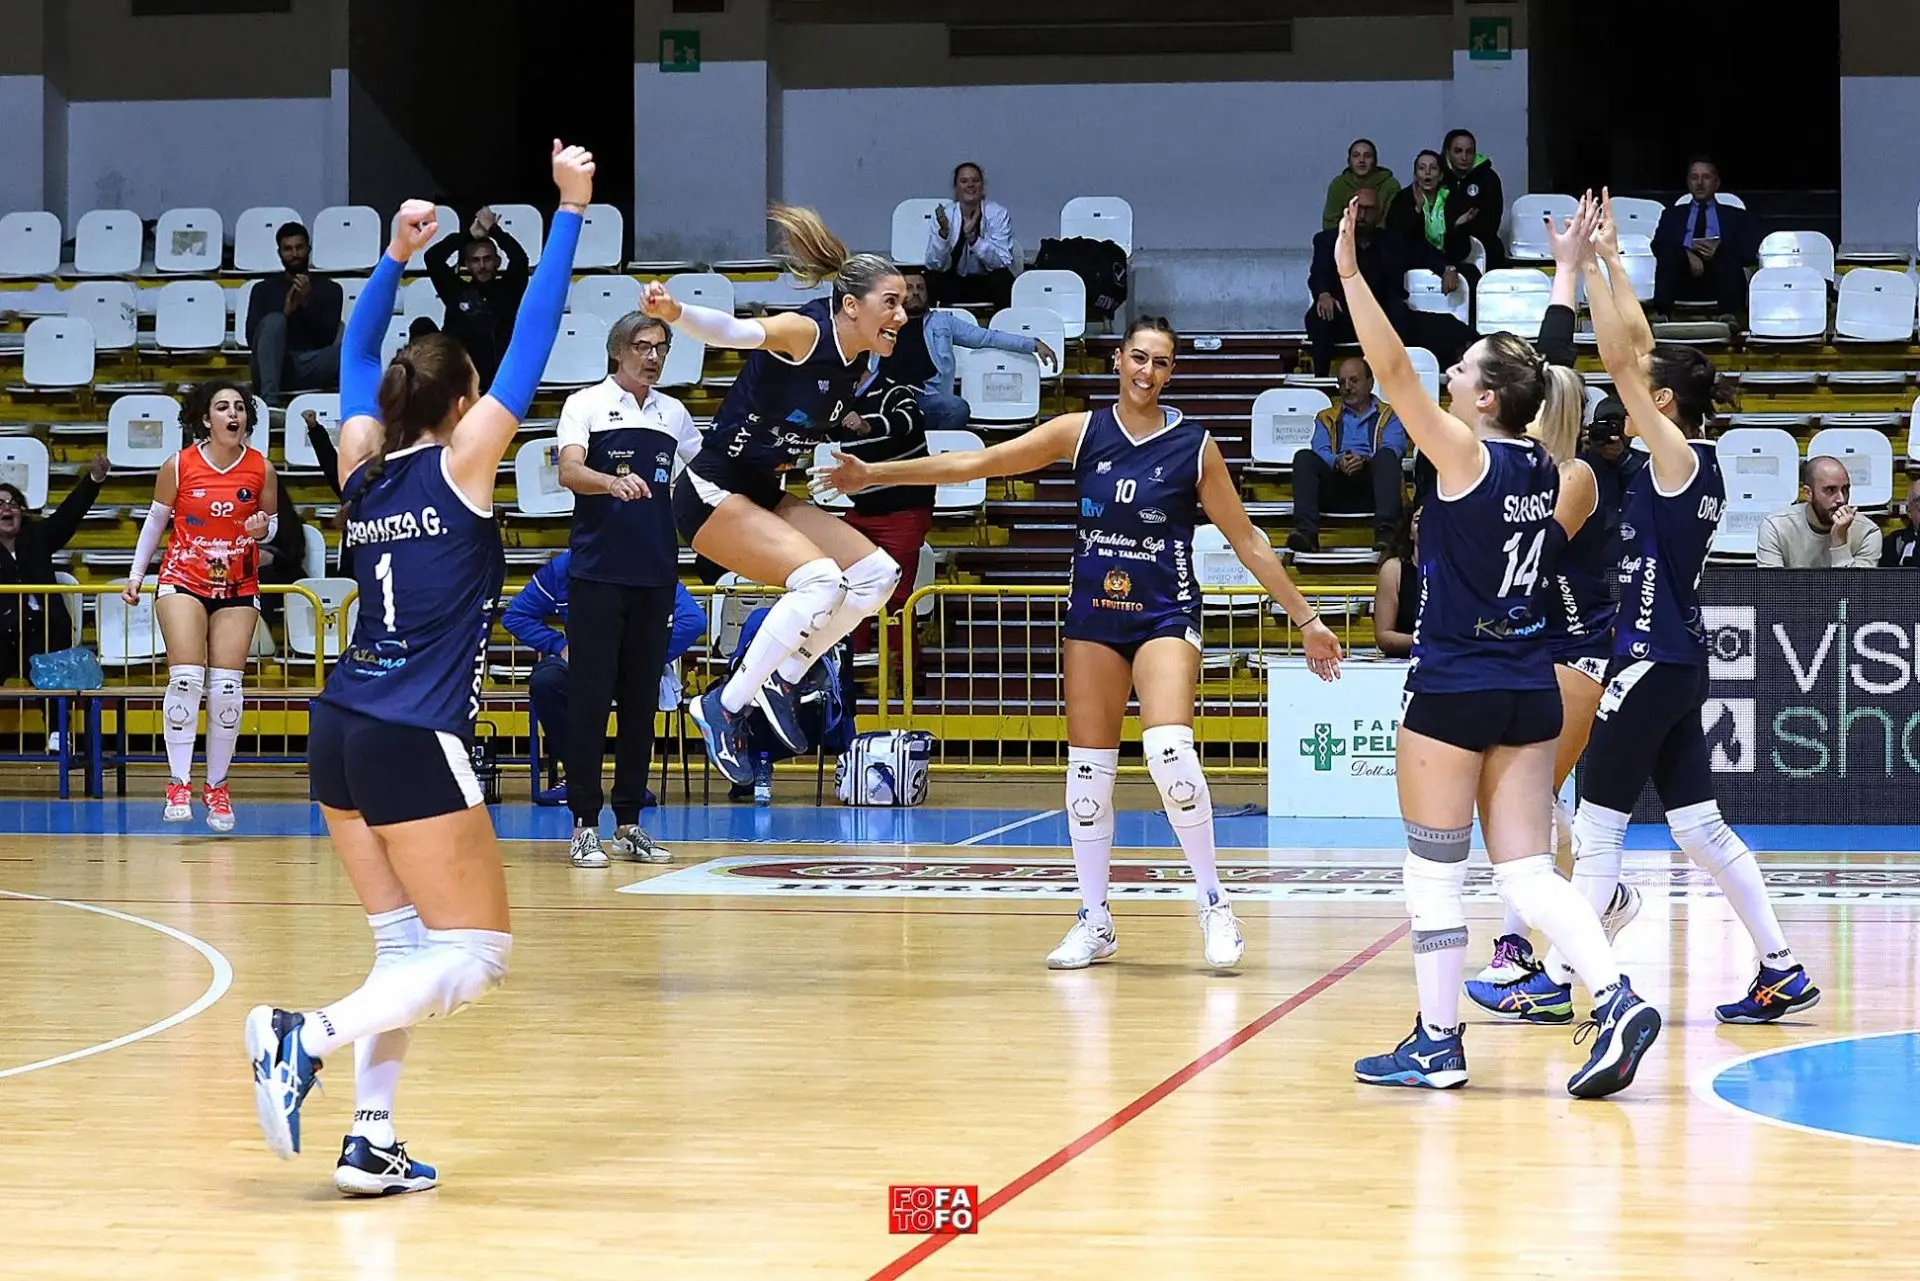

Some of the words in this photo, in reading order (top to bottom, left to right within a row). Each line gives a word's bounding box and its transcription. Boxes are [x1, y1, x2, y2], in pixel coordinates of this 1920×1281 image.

[1115, 478, 1137, 504] 10
[210, 501, 234, 517] 92
[421, 506, 448, 536] G.
[1089, 529, 1138, 548] Fashion
[1173, 539, 1193, 601] REGHION
[1497, 528, 1546, 598] 14
[374, 552, 397, 632] 1
[1092, 598, 1100, 608] IL
[1101, 599, 1144, 612] FRUTTETO
[1635, 556, 1657, 633] REGHION
